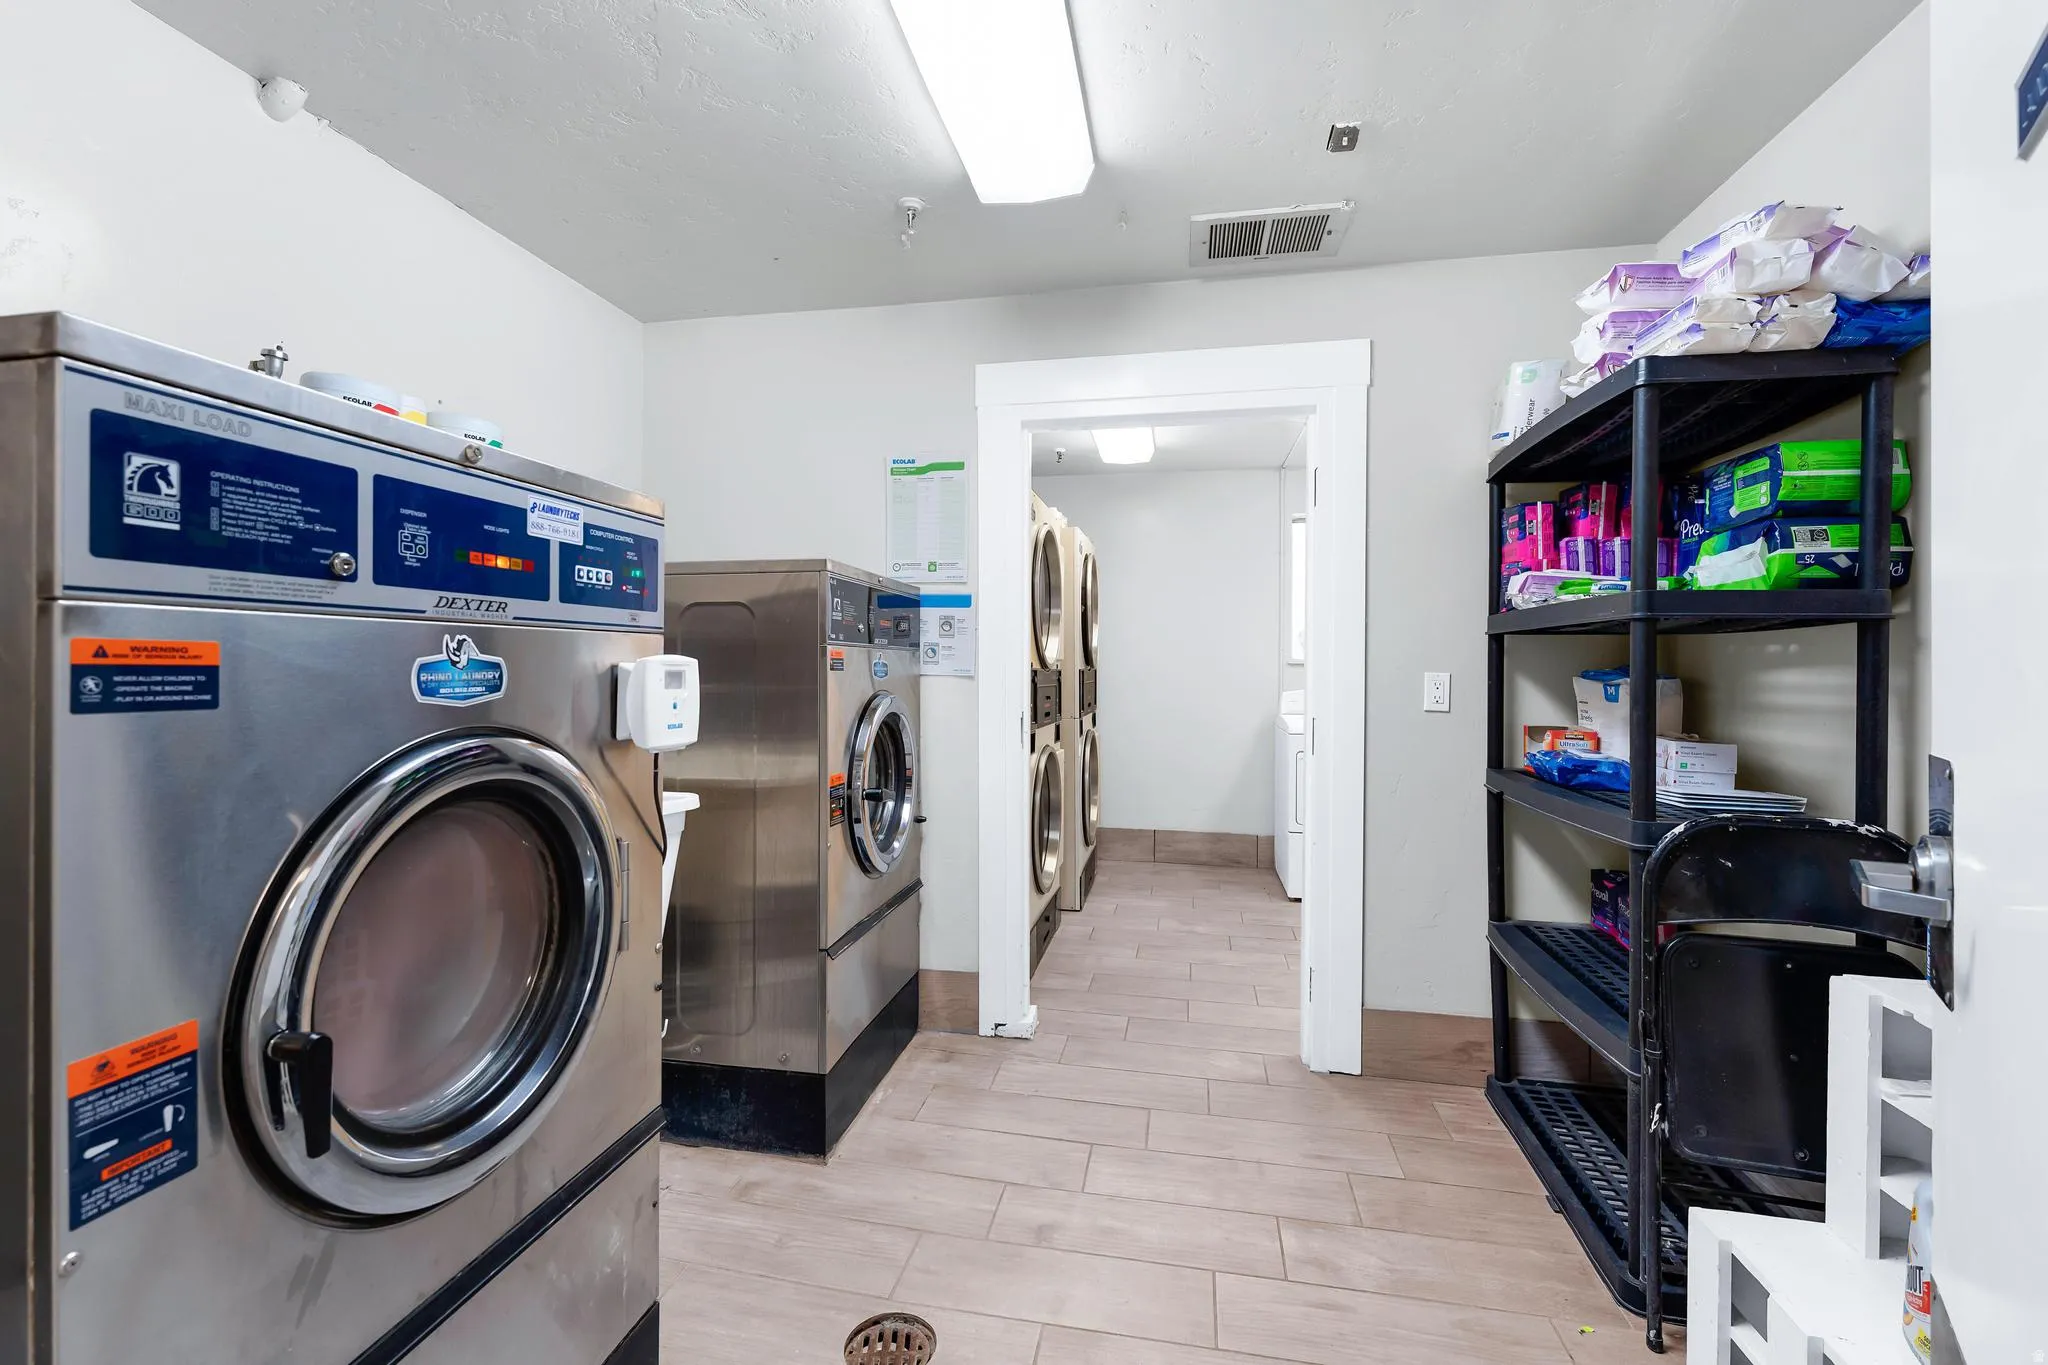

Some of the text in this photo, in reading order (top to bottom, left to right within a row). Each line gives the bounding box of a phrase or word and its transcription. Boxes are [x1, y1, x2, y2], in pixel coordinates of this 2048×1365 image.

[343, 396, 372, 407] ECOLAB
[124, 392, 252, 437] MAXI LOAD
[464, 433, 486, 442] ECOLAB
[209, 470, 300, 493] OPERATING INSTRUCTIONS
[590, 529, 634, 544] COMPUTER CONTROL
[1804, 554, 1816, 564] 25
[432, 596, 508, 613] DEXTER
[129, 645, 188, 653] WARNING
[421, 671, 500, 681] RHINO LAUNDRY
[1607, 686, 1616, 696] M
